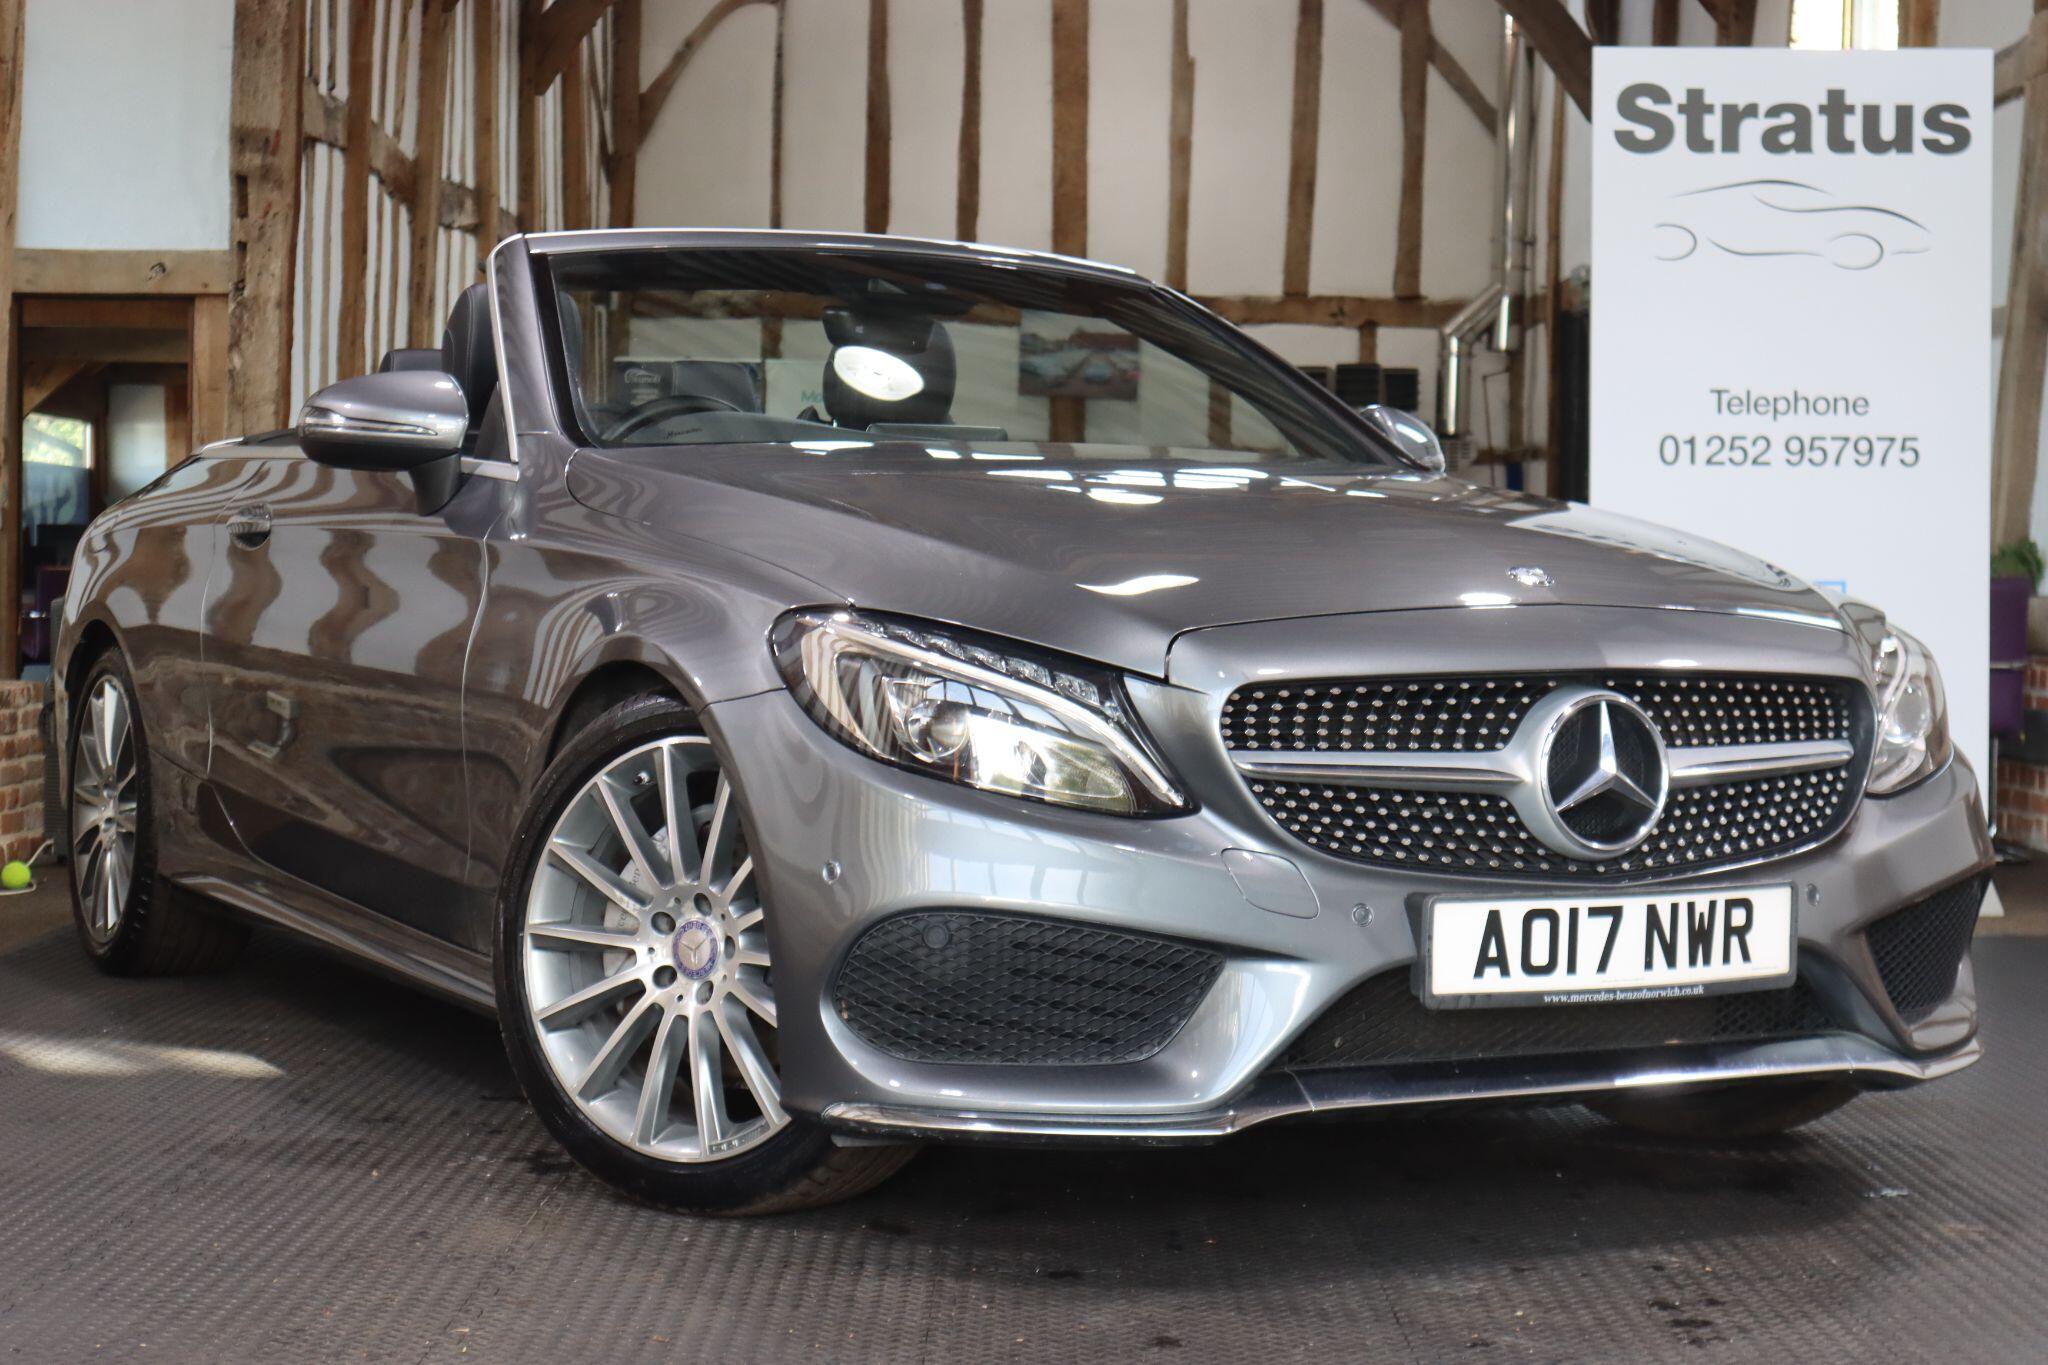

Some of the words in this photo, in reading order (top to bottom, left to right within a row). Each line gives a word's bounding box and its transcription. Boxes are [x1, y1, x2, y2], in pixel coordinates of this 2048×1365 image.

[1614, 83, 1971, 155] Stratus
[1709, 389, 1870, 421] Telephone
[1659, 434, 1772, 467] 01252
[1784, 435, 1921, 468] 957975
[1473, 906, 1625, 980] AO17
[1644, 897, 1754, 973] NWR
[1543, 984, 1705, 1004] www.mercedes-benzofnorwich.co.uk
